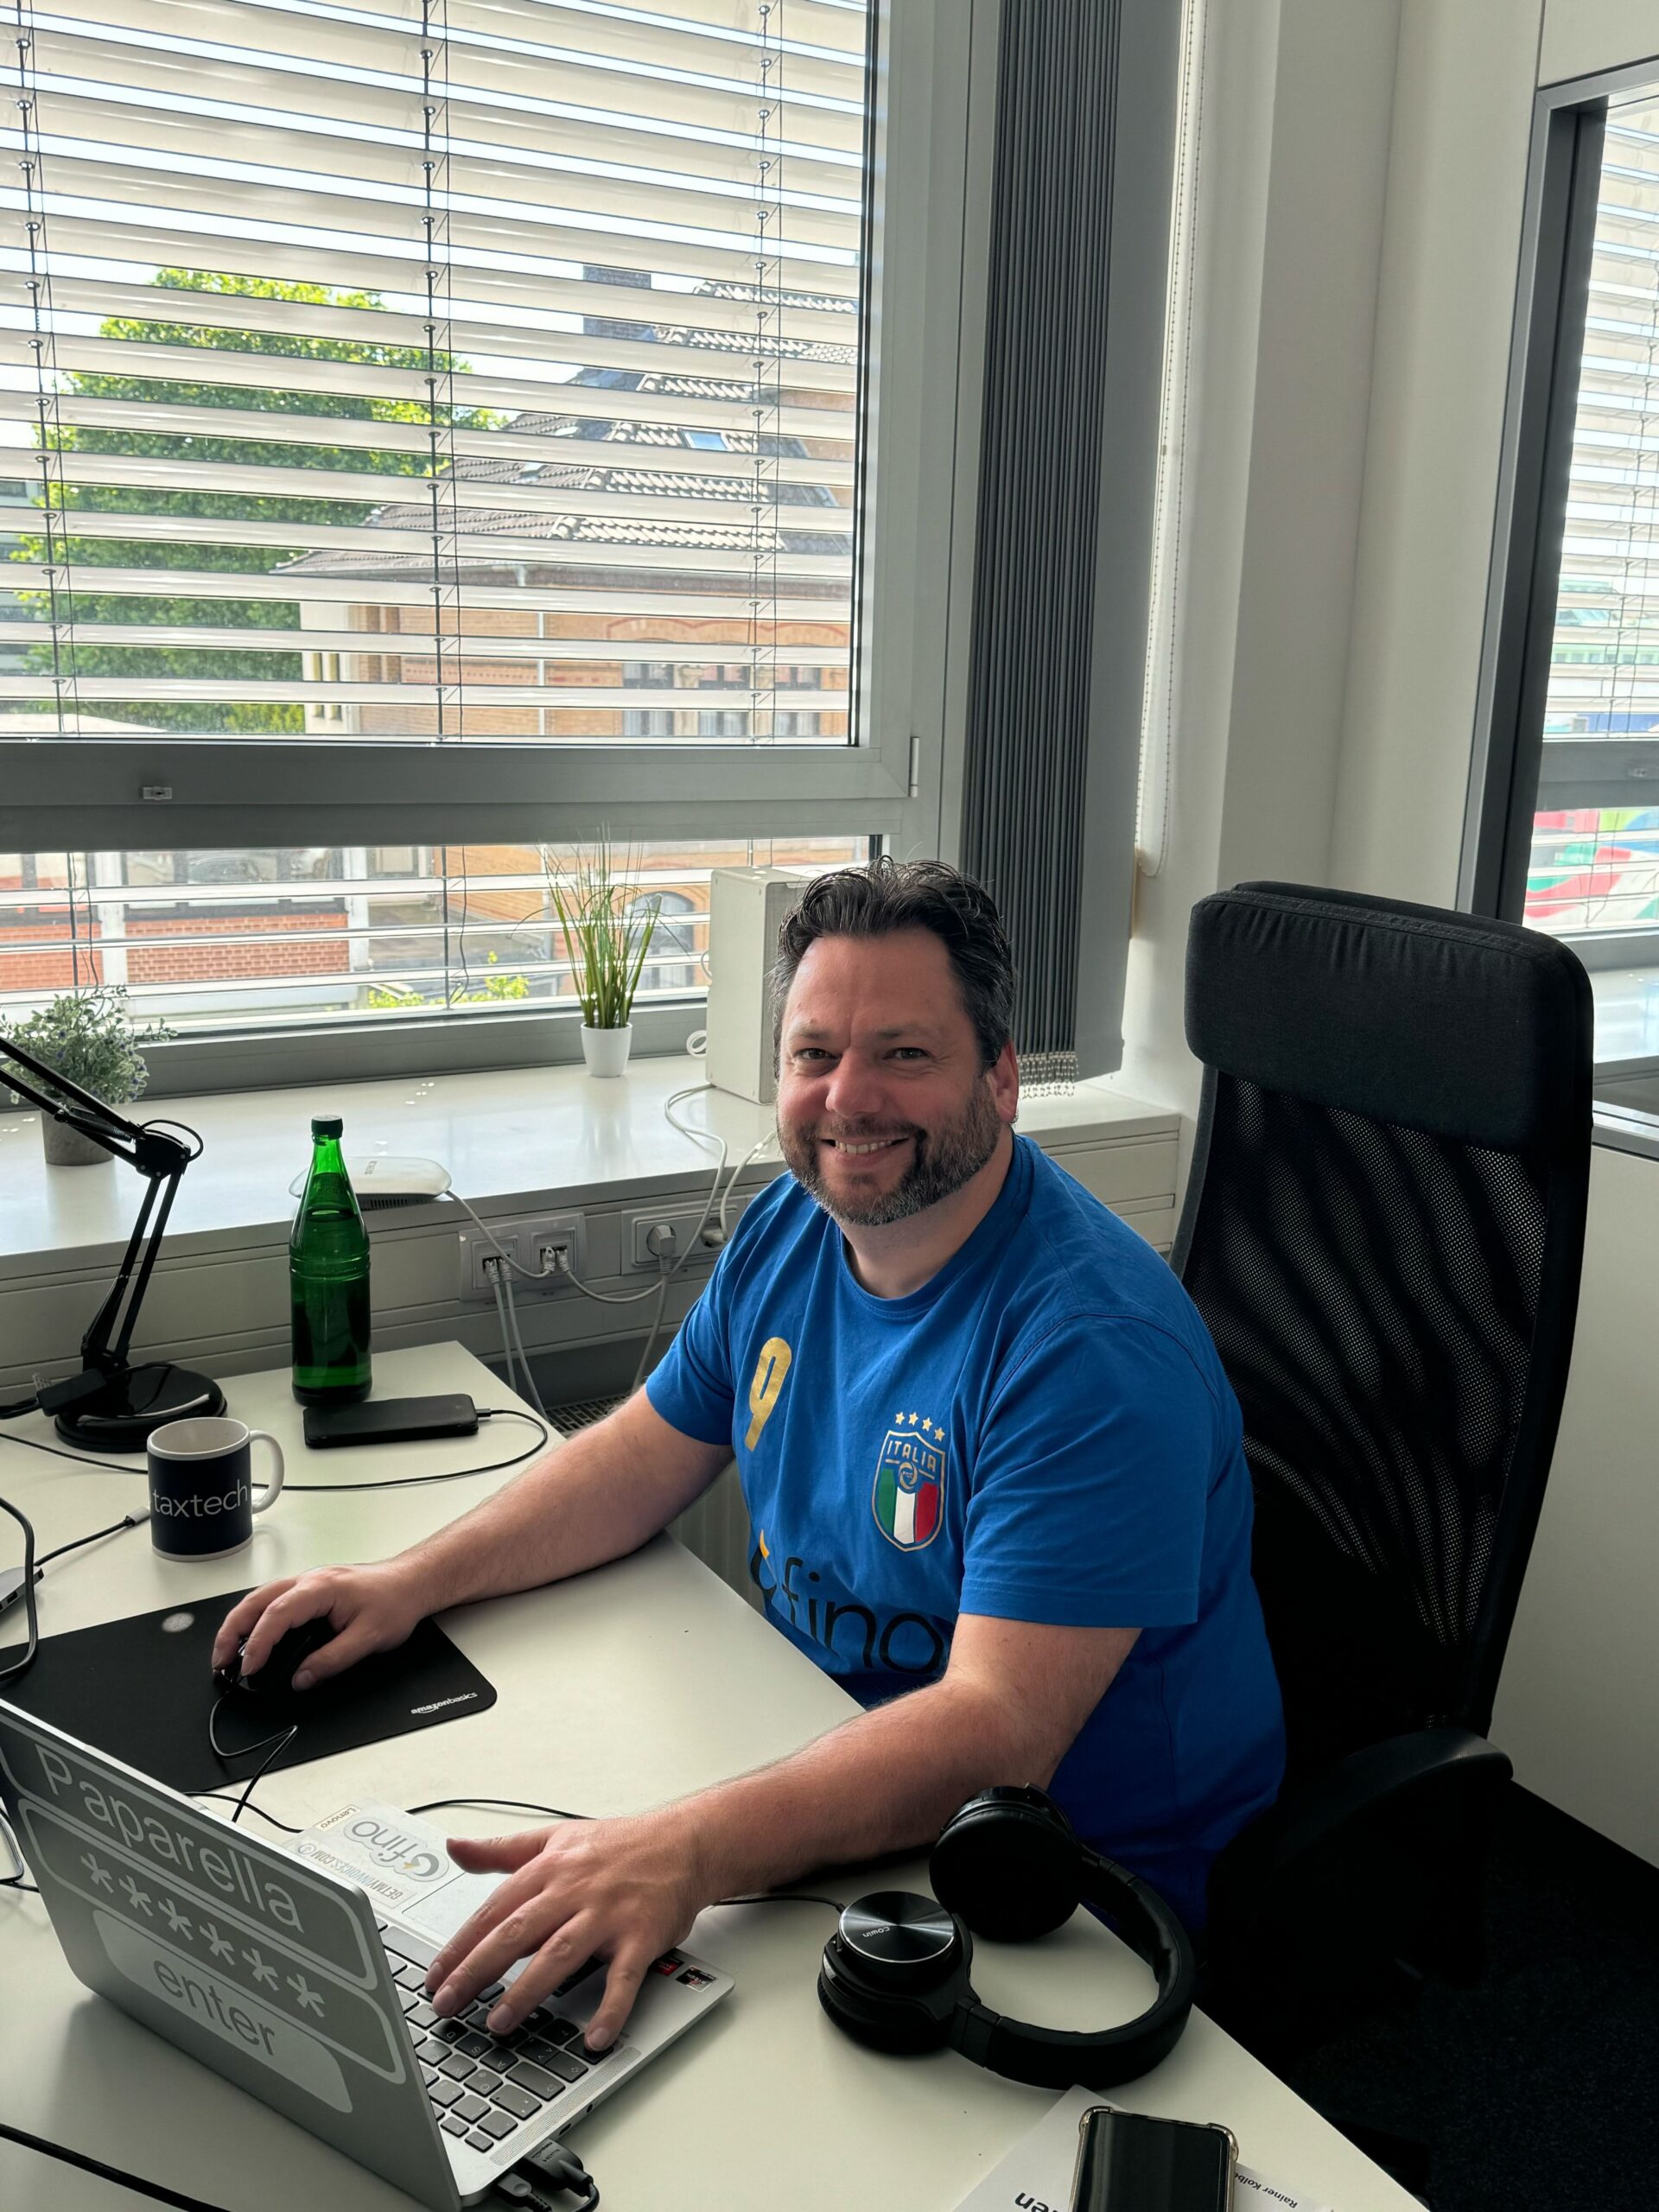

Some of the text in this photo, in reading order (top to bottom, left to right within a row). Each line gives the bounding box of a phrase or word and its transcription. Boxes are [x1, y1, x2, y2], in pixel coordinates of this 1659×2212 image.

[745, 1337, 792, 1452] 9
[887, 1440, 937, 1471] ITALIA
[152, 1478, 249, 1518] taxtech
[410, 1691, 479, 1714] amazonbasics
[321, 1808, 357, 1828] Lenovo
[35, 1744, 305, 1934] Paparella
[351, 1821, 418, 1862] fino
[862, 1926, 890, 1938] cowin
[153, 1960, 276, 2056] enter
[1262, 2186, 1299, 2209] Rainer
